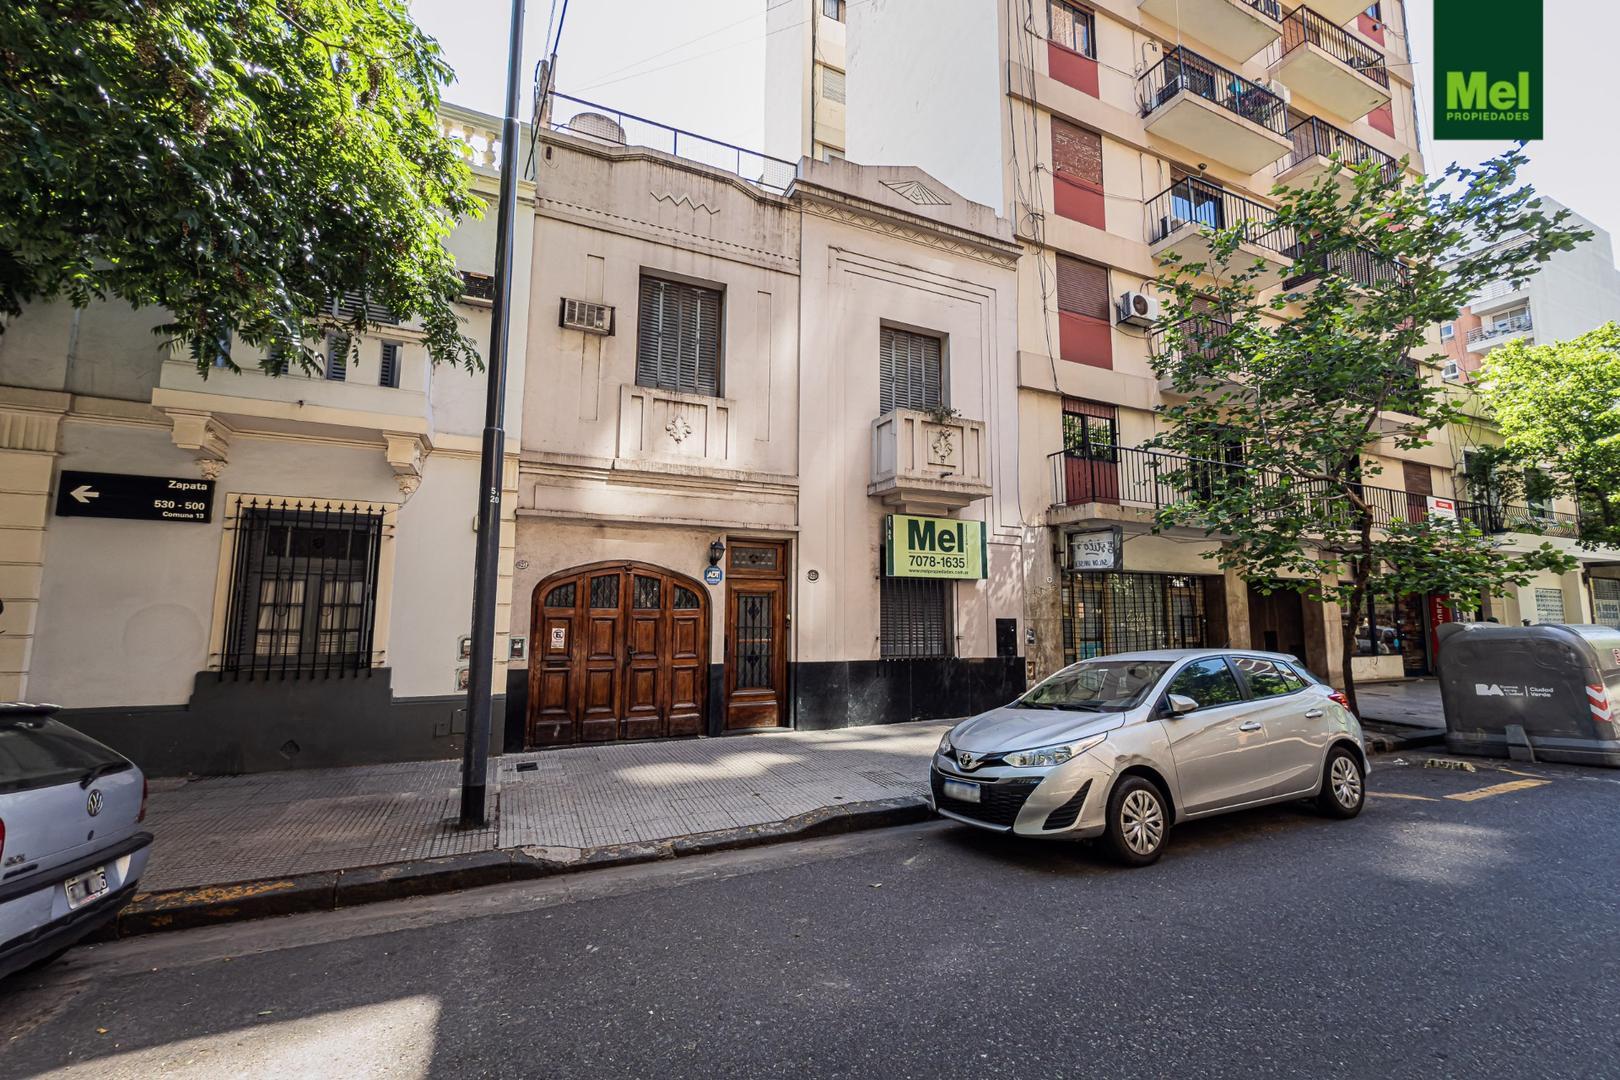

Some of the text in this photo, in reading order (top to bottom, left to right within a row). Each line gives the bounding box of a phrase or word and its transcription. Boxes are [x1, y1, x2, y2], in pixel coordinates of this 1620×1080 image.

[168, 480, 208, 490] Zapata
[154, 500, 175, 509] 530
[185, 501, 205, 511] 500
[908, 519, 964, 553] Mel
[908, 555, 965, 568] 7078-1635
